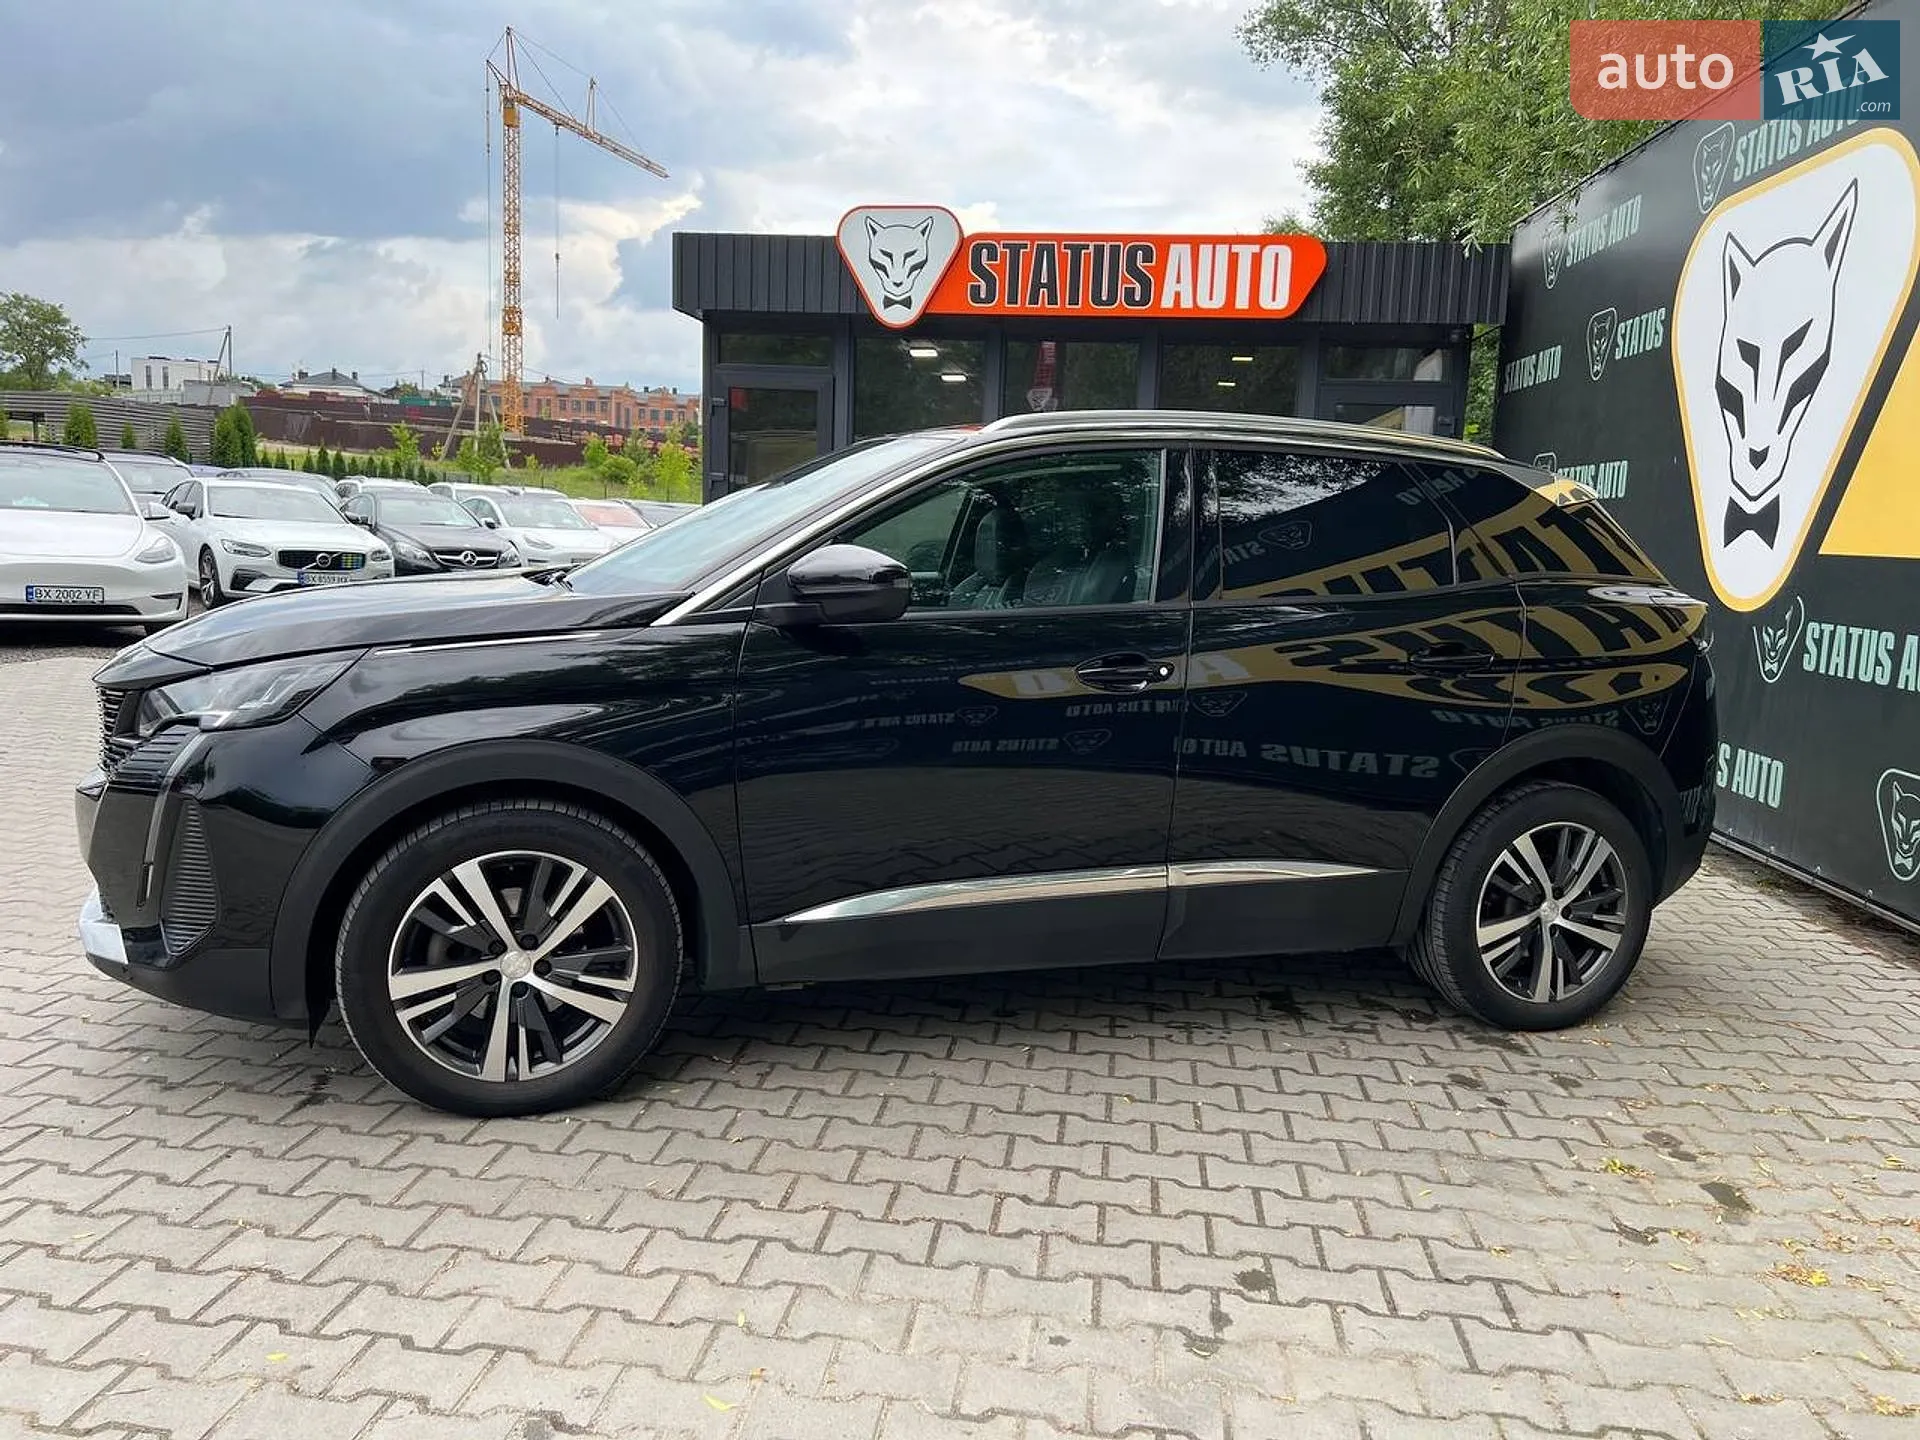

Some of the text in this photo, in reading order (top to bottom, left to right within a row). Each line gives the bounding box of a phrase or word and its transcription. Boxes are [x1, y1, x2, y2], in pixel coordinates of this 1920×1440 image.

[1732, 103, 1805, 183] STATUS
[1565, 194, 1642, 268] STATUS AUTO
[968, 240, 1292, 310] STATUS AUTO
[1615, 307, 1667, 360] STATUS
[1504, 344, 1562, 394] STATUS AUTO
[1597, 460, 1628, 499] AUTO
[35, 588, 51, 599] BX
[55, 589, 82, 600] 2002
[1803, 622, 1920, 693] STATUS A
[1731, 748, 1784, 808] AUTO
